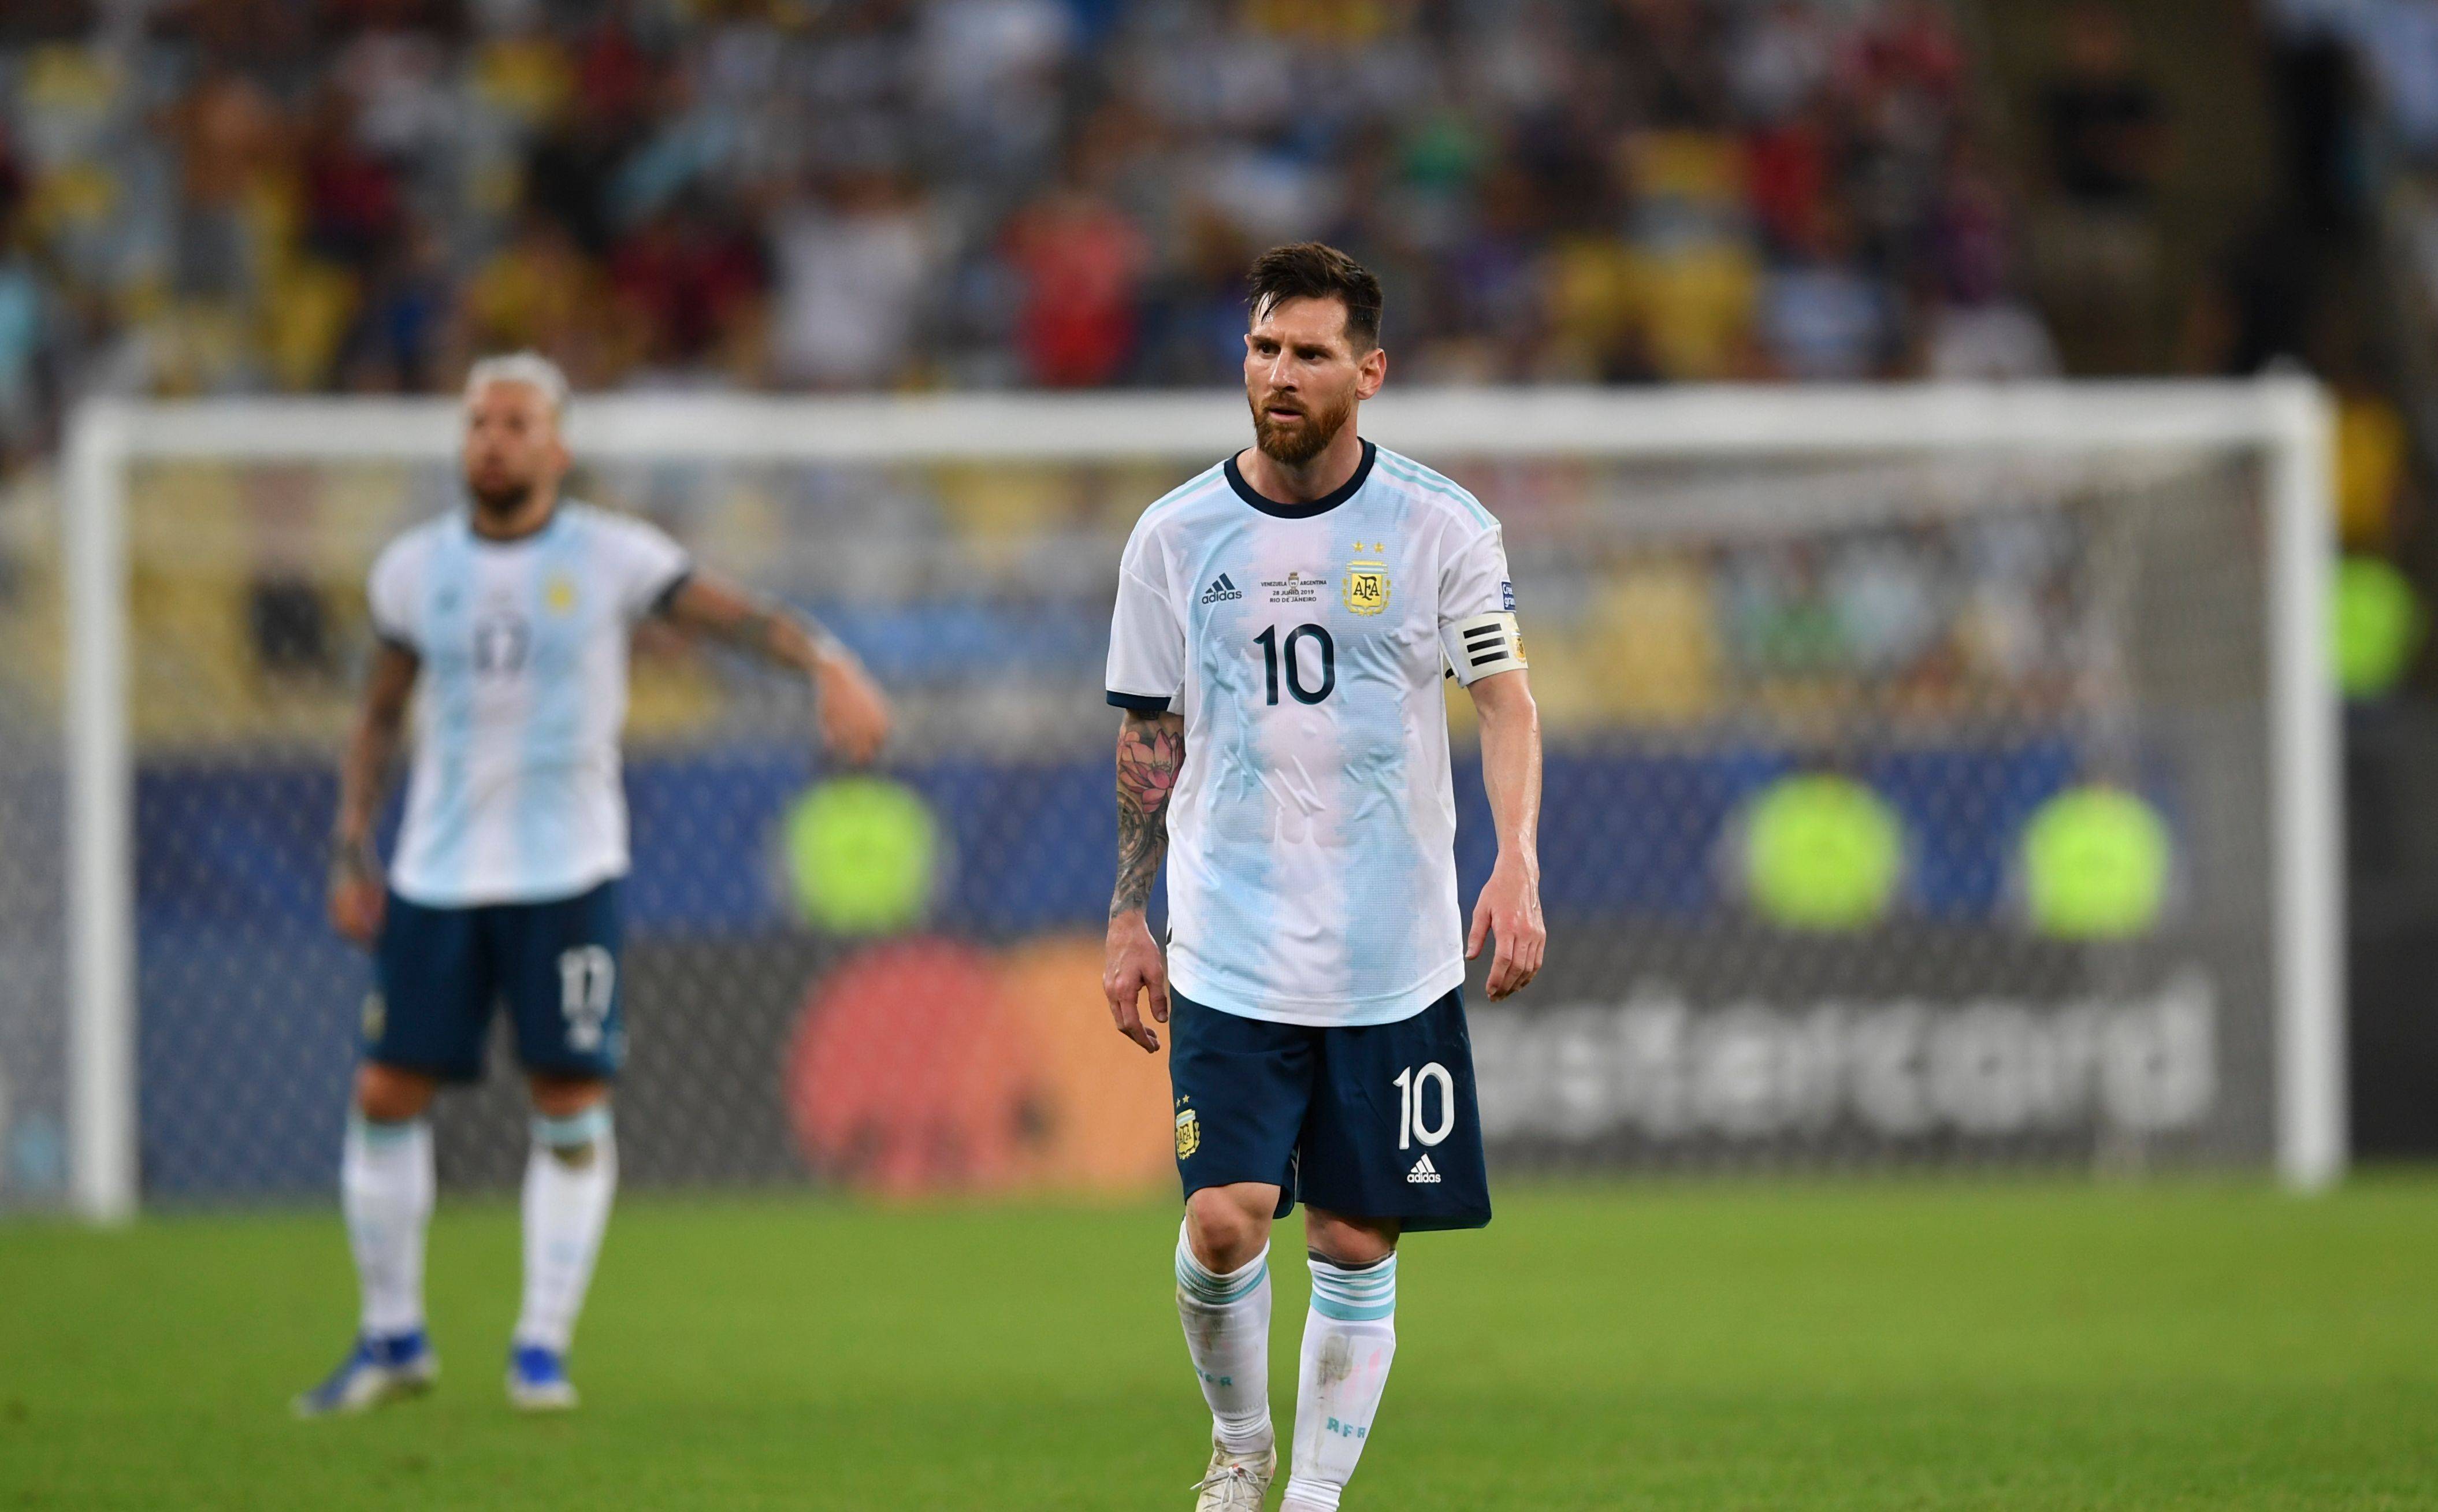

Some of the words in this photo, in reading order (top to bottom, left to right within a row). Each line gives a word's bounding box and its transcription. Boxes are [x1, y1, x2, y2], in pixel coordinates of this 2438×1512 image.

[1202, 590, 1242, 604] adidas
[1353, 575, 1380, 600] AFA
[1253, 623, 1336, 705] 10
[1392, 1062, 1455, 1150] 10
[1407, 1172, 1441, 1183] adidas
[1326, 1417, 1366, 1438] AFA
